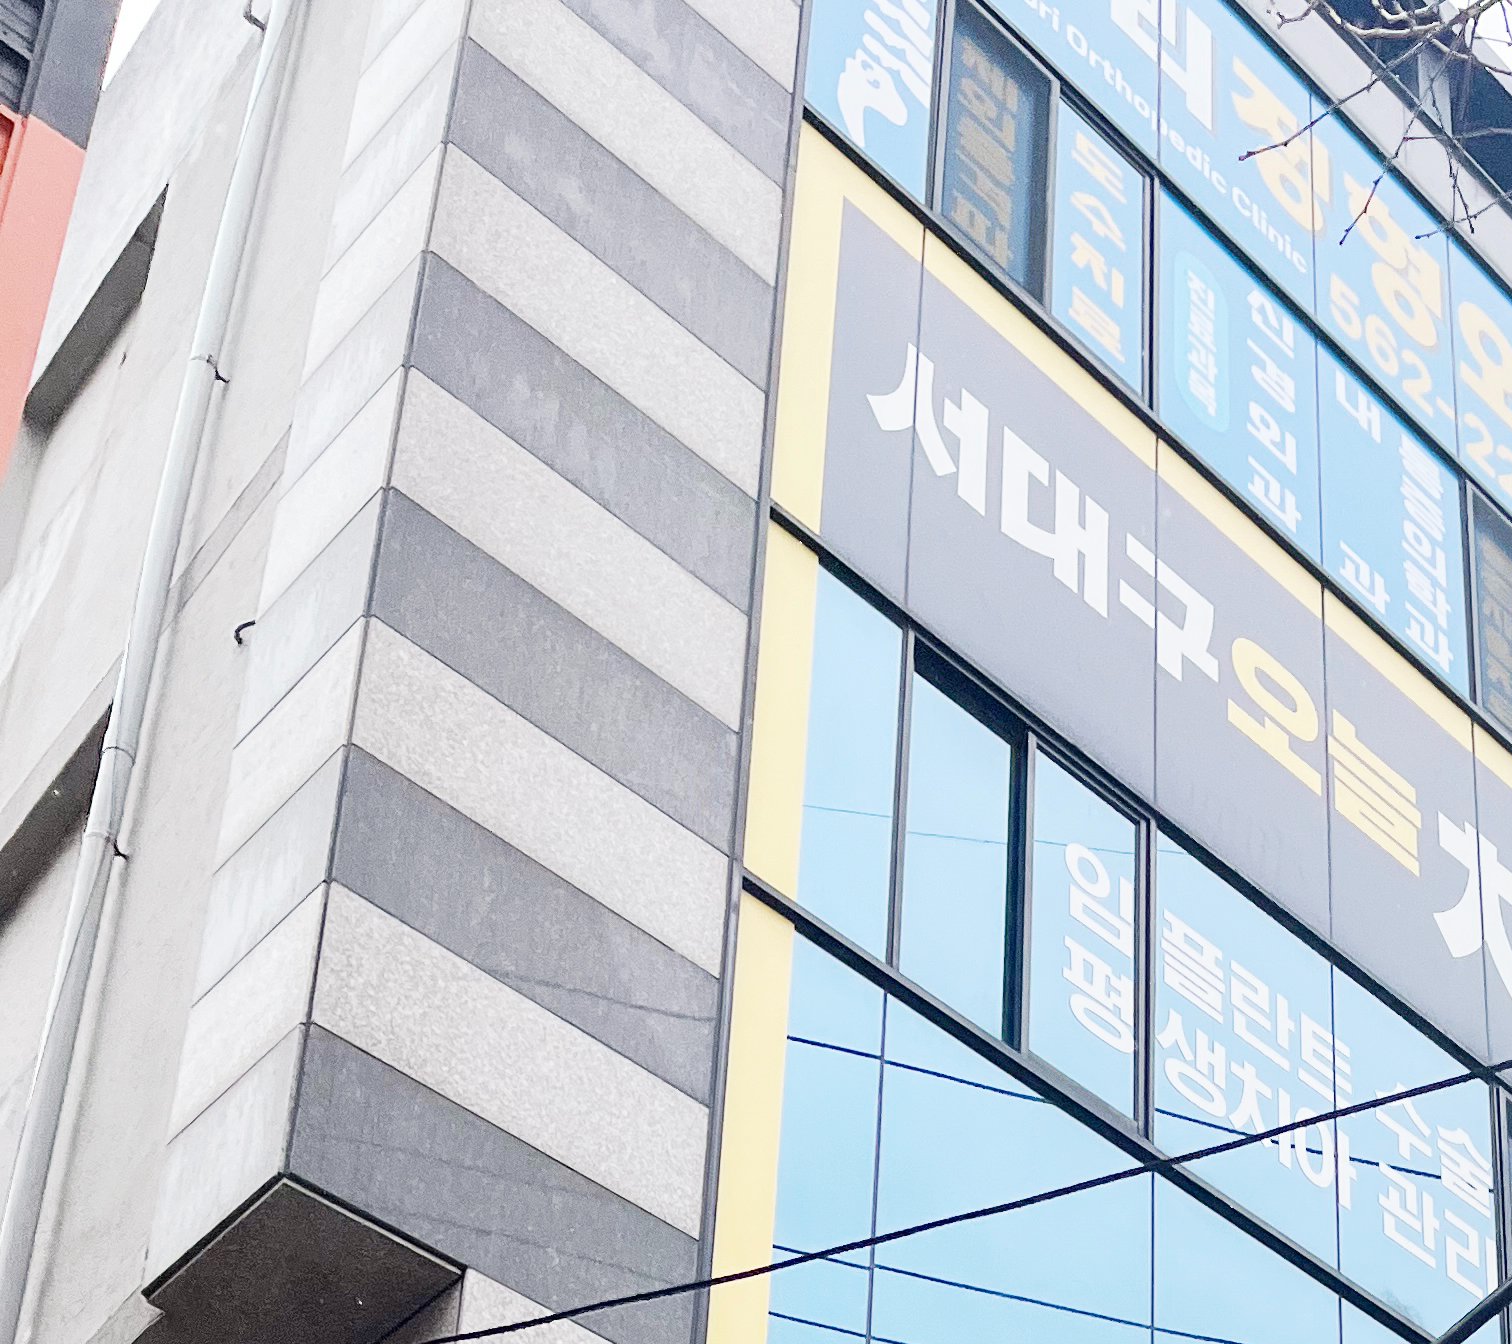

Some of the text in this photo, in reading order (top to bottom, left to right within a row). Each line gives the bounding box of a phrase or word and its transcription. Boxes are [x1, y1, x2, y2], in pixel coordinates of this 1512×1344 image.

[1067, 25, 1228, 195] Orthopedic
[1232, 186, 1308, 273] Clinic
[1068, 130, 1127, 364] 도수치료
[1187, 270, 1217, 418] 진료과목
[1246, 288, 1302, 534] 신경외과
[1400, 432, 1455, 673] 통증의학과
[1061, 936, 1500, 1300] 평생치아 관리
[1065, 842, 1493, 1219] 임플란트 수술
